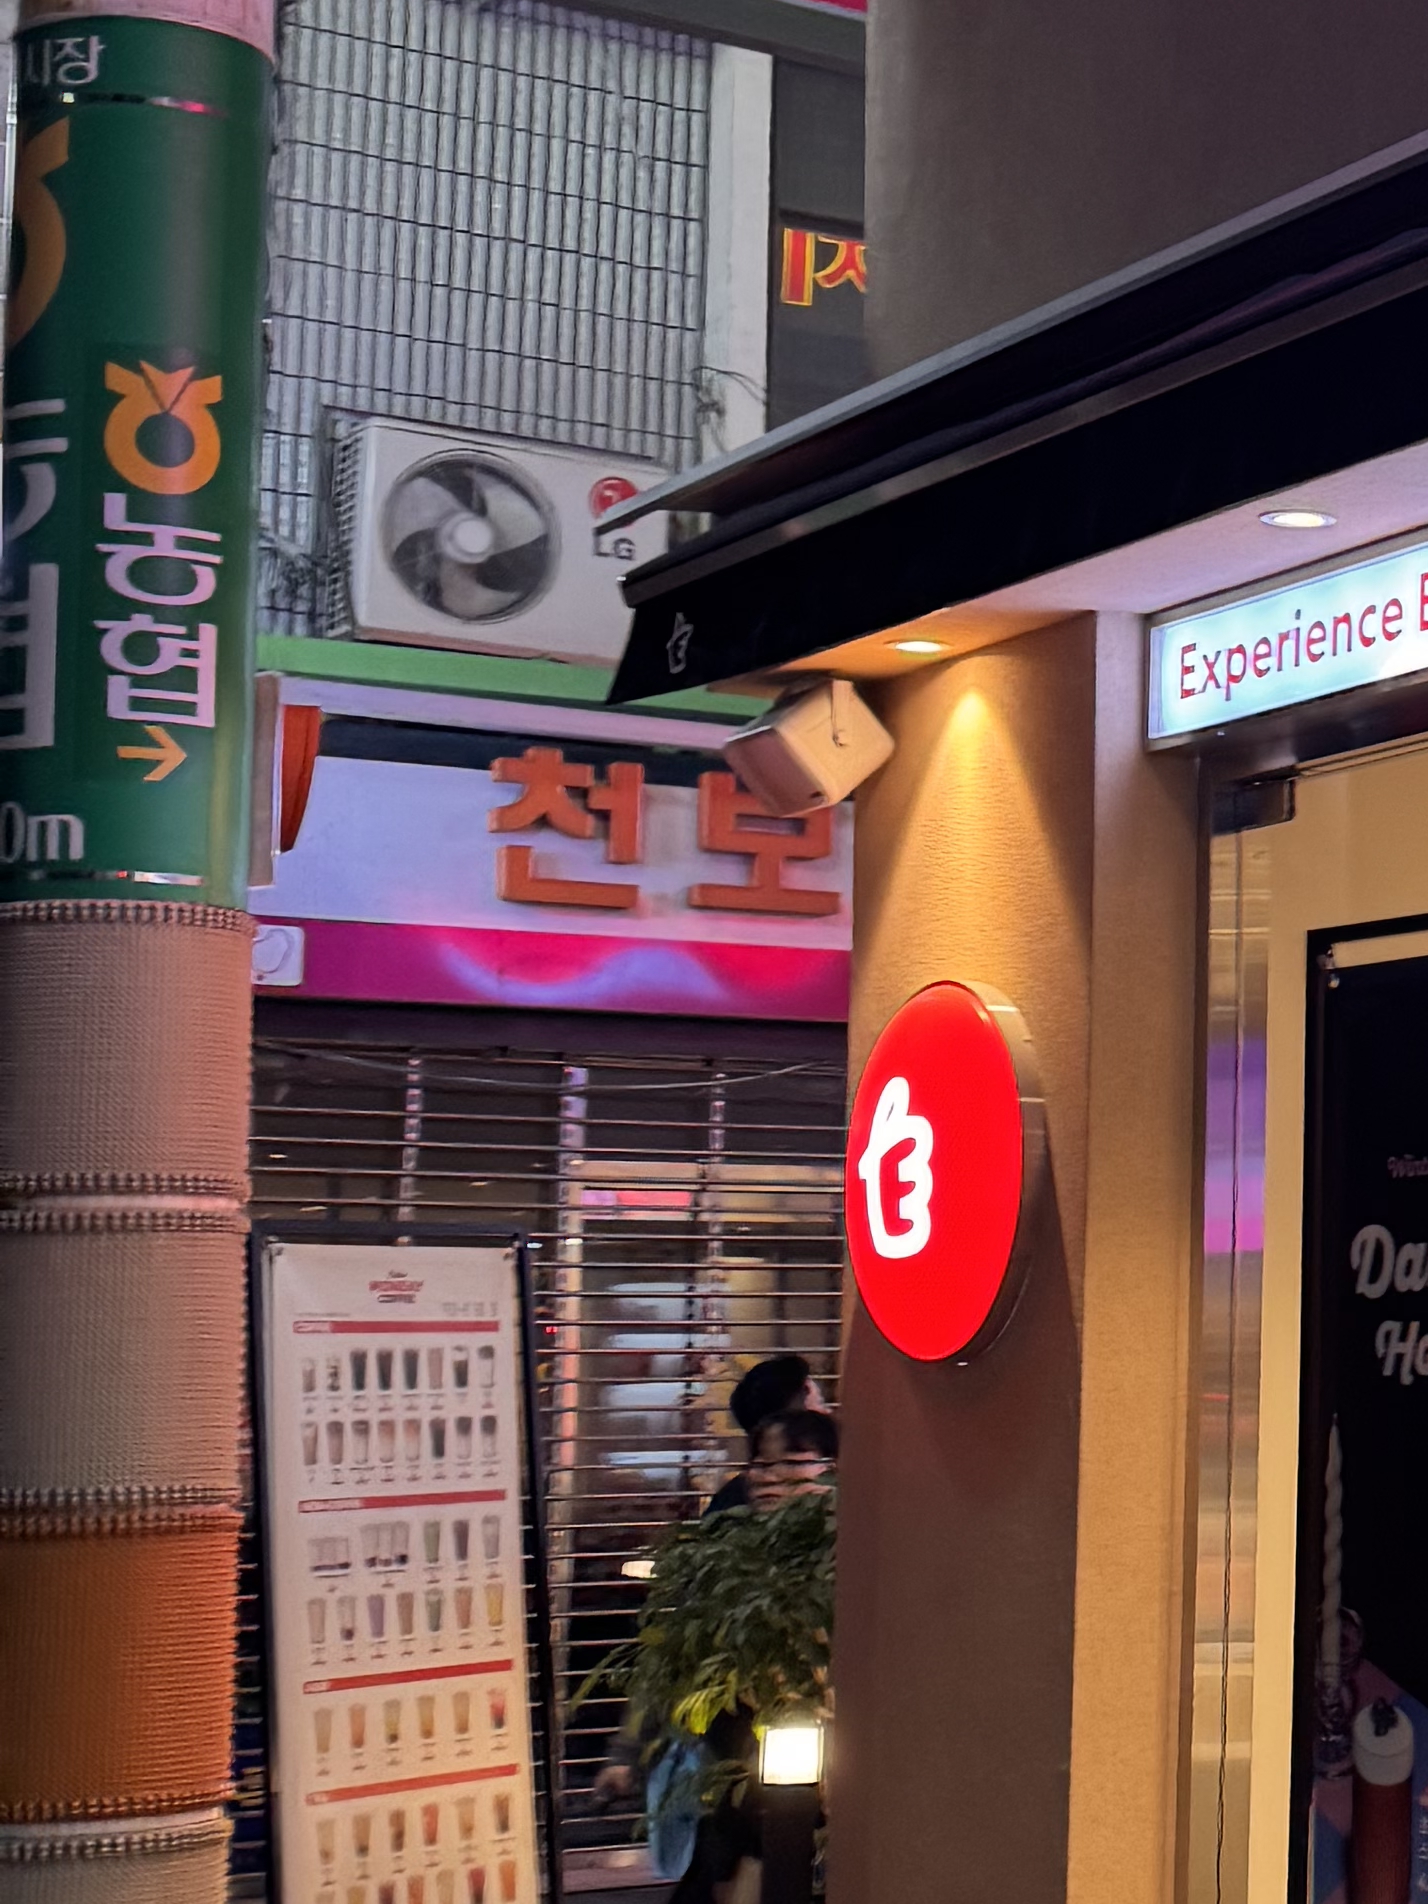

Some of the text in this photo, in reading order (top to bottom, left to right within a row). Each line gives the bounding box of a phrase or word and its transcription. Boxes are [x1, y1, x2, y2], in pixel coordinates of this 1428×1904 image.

[95, 492, 222, 729] 농협
[592, 526, 636, 562] LG
[1180, 597, 1403, 702] Experience
[487, 747, 842, 917] 천보
